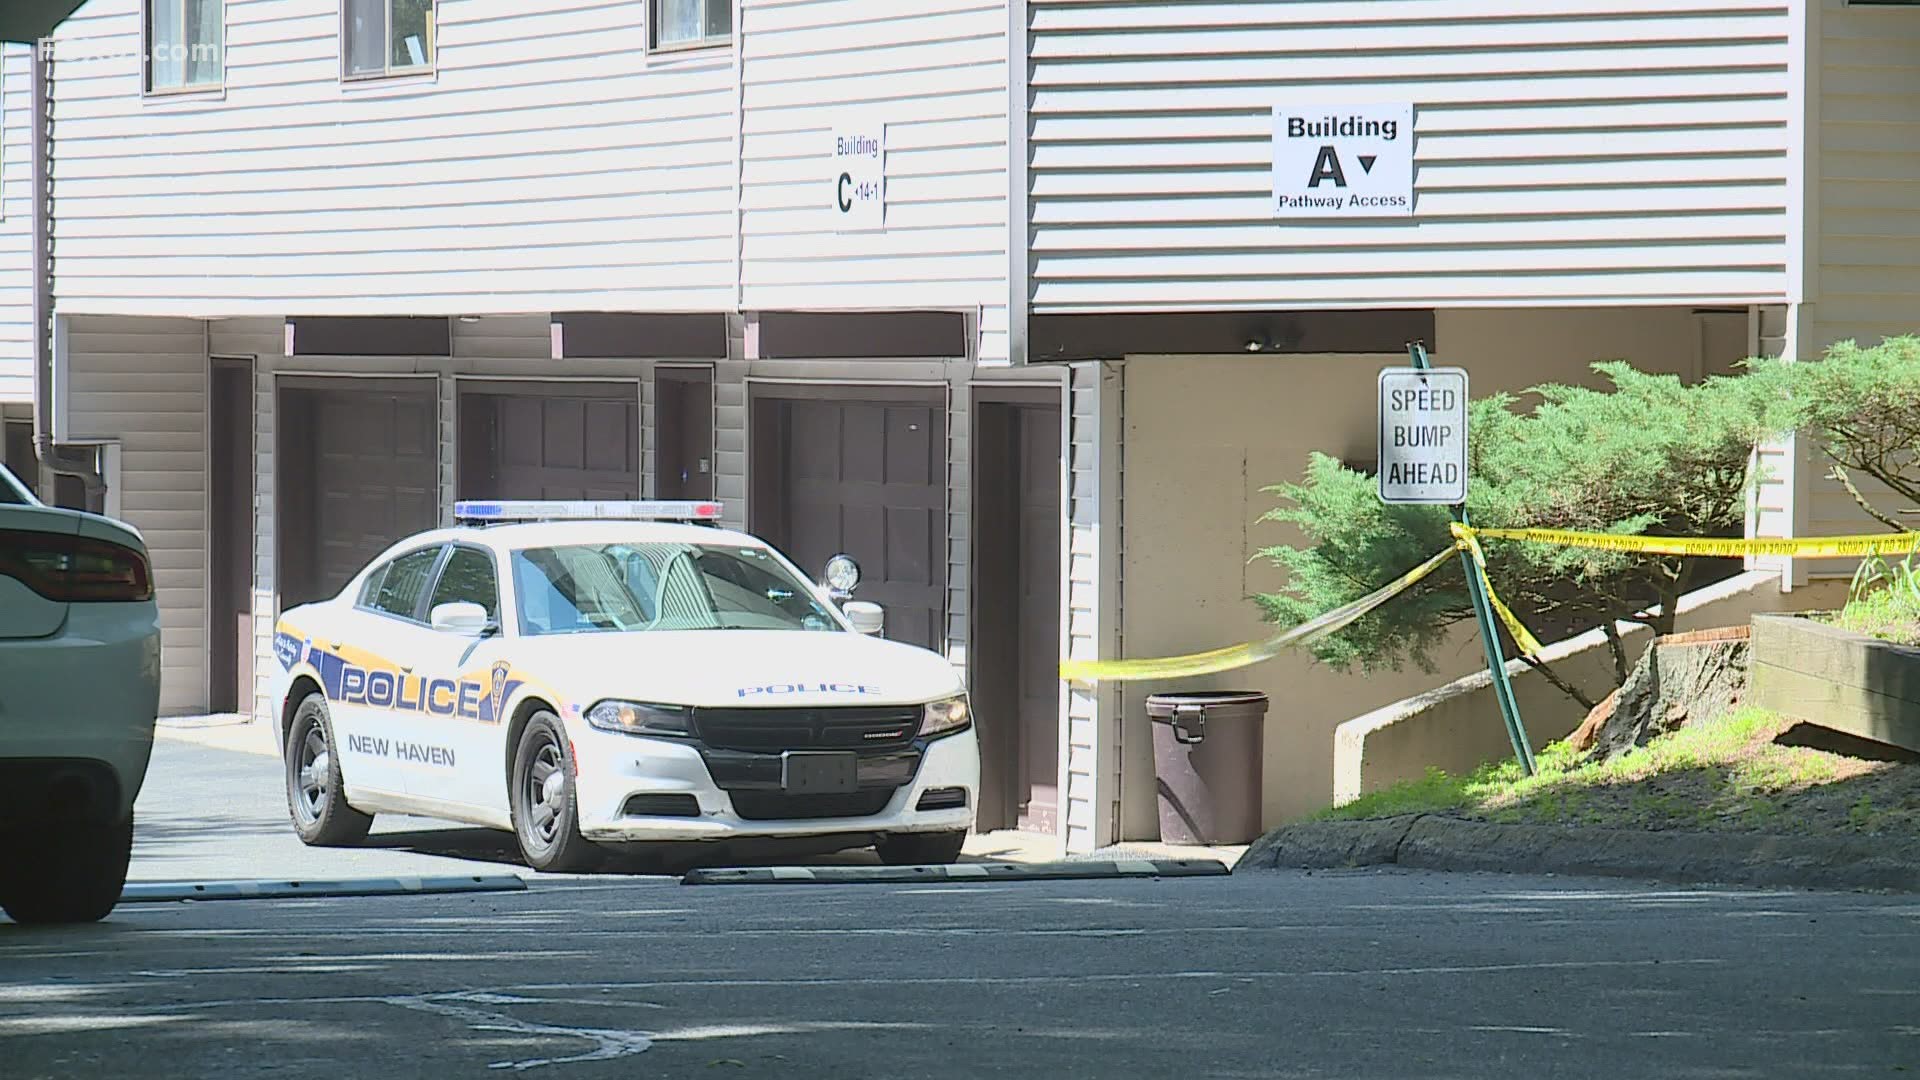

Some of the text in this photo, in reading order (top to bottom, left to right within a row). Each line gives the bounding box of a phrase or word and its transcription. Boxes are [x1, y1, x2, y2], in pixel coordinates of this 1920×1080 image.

[1287, 116, 1397, 140] Building
[837, 136, 878, 158] Building
[1307, 145, 1347, 187] A
[837, 171, 852, 213] C
[1279, 194, 1406, 210] Pathway Access
[1391, 389, 1455, 412] SPEED
[1394, 426, 1452, 447] BUMP
[1388, 463, 1458, 485] AHEAD
[339, 663, 482, 720] POLICE
[737, 683, 882, 698] POLICE
[348, 733, 455, 768] NEW HAVEN
